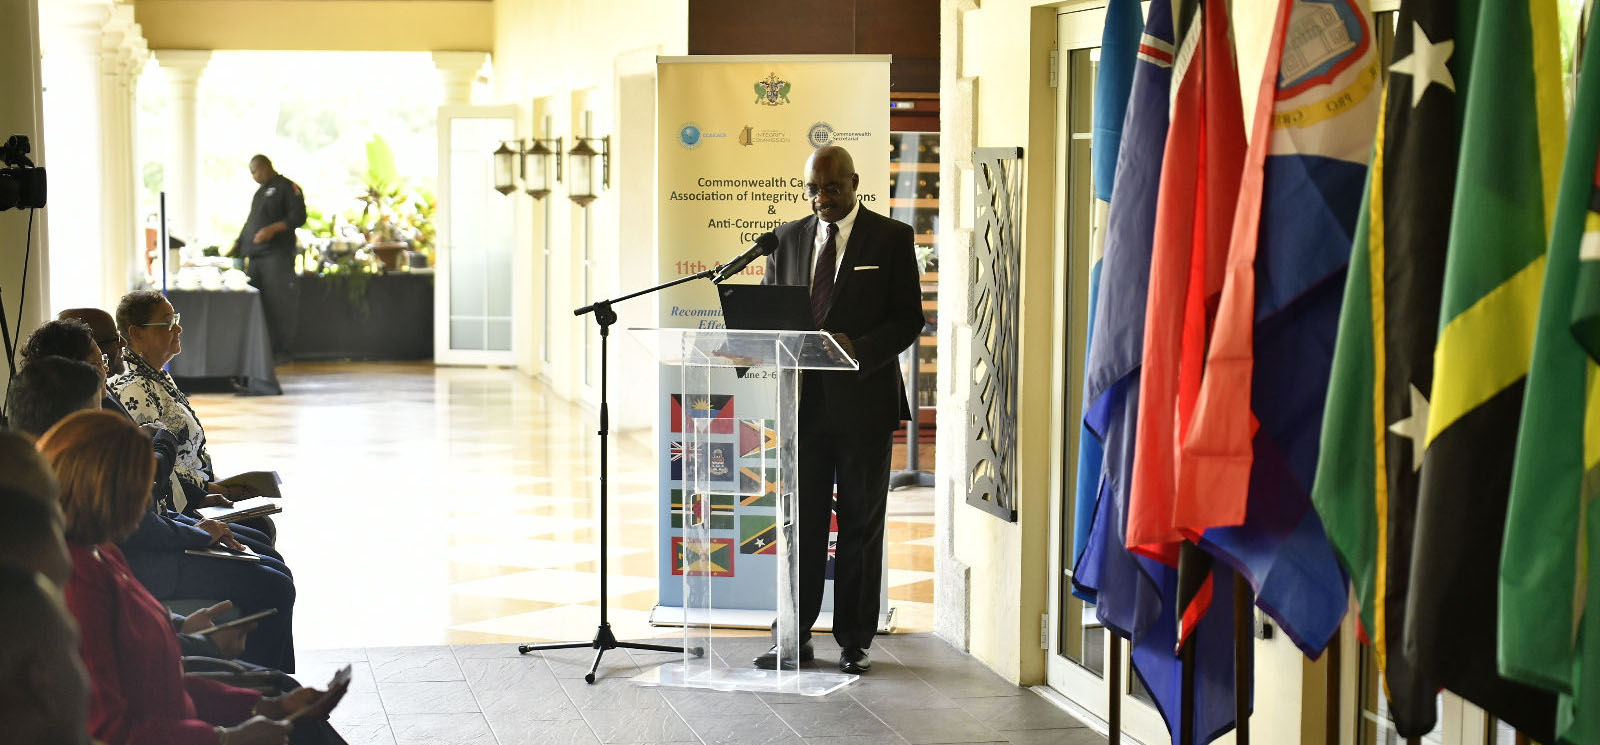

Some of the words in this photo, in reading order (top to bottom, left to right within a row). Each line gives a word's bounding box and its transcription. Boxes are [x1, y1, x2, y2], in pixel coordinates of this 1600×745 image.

[697, 177, 787, 187] Commonwealth
[669, 191, 733, 201] Association
[736, 191, 749, 201] of
[751, 191, 799, 204] Integrity
[767, 204, 777, 215] &
[675, 260, 707, 275] 11th
[671, 305, 724, 317] Recommi
